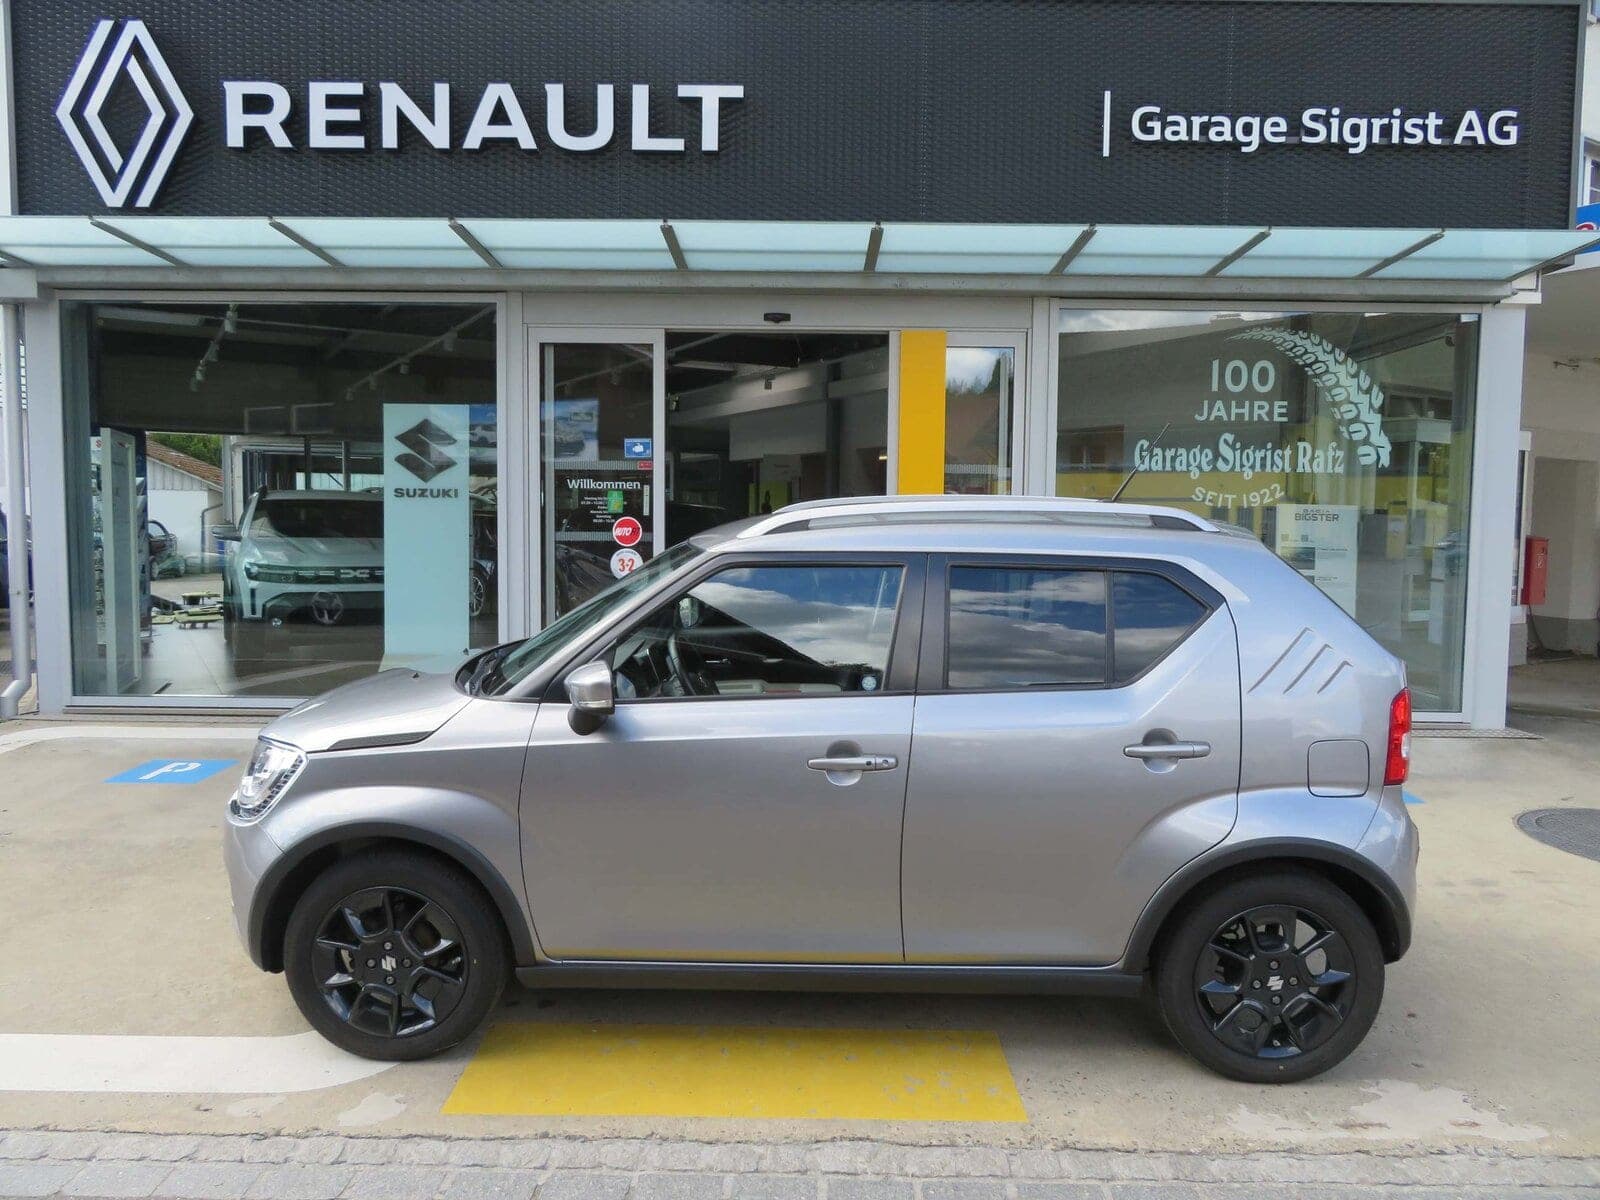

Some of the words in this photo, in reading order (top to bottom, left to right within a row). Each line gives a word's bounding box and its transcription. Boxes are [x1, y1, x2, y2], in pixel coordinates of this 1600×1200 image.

[223, 81, 745, 152] RENAULT
[1130, 105, 1287, 153] Garage
[1301, 106, 1443, 155] Sigrist
[1453, 109, 1519, 147] AG
[1211, 358, 1276, 393] 100
[1194, 399, 1289, 423] JAHRE
[1134, 438, 1214, 480] Garage
[1216, 432, 1293, 481] Sigrist
[1296, 441, 1345, 475] Rafz
[393, 487, 459, 499] SUZUKI
[566, 478, 641, 490] Willkommen
[1191, 485, 1237, 509] SEIT
[1242, 482, 1285, 508] 1922
[1294, 513, 1340, 522] BIGSTER
